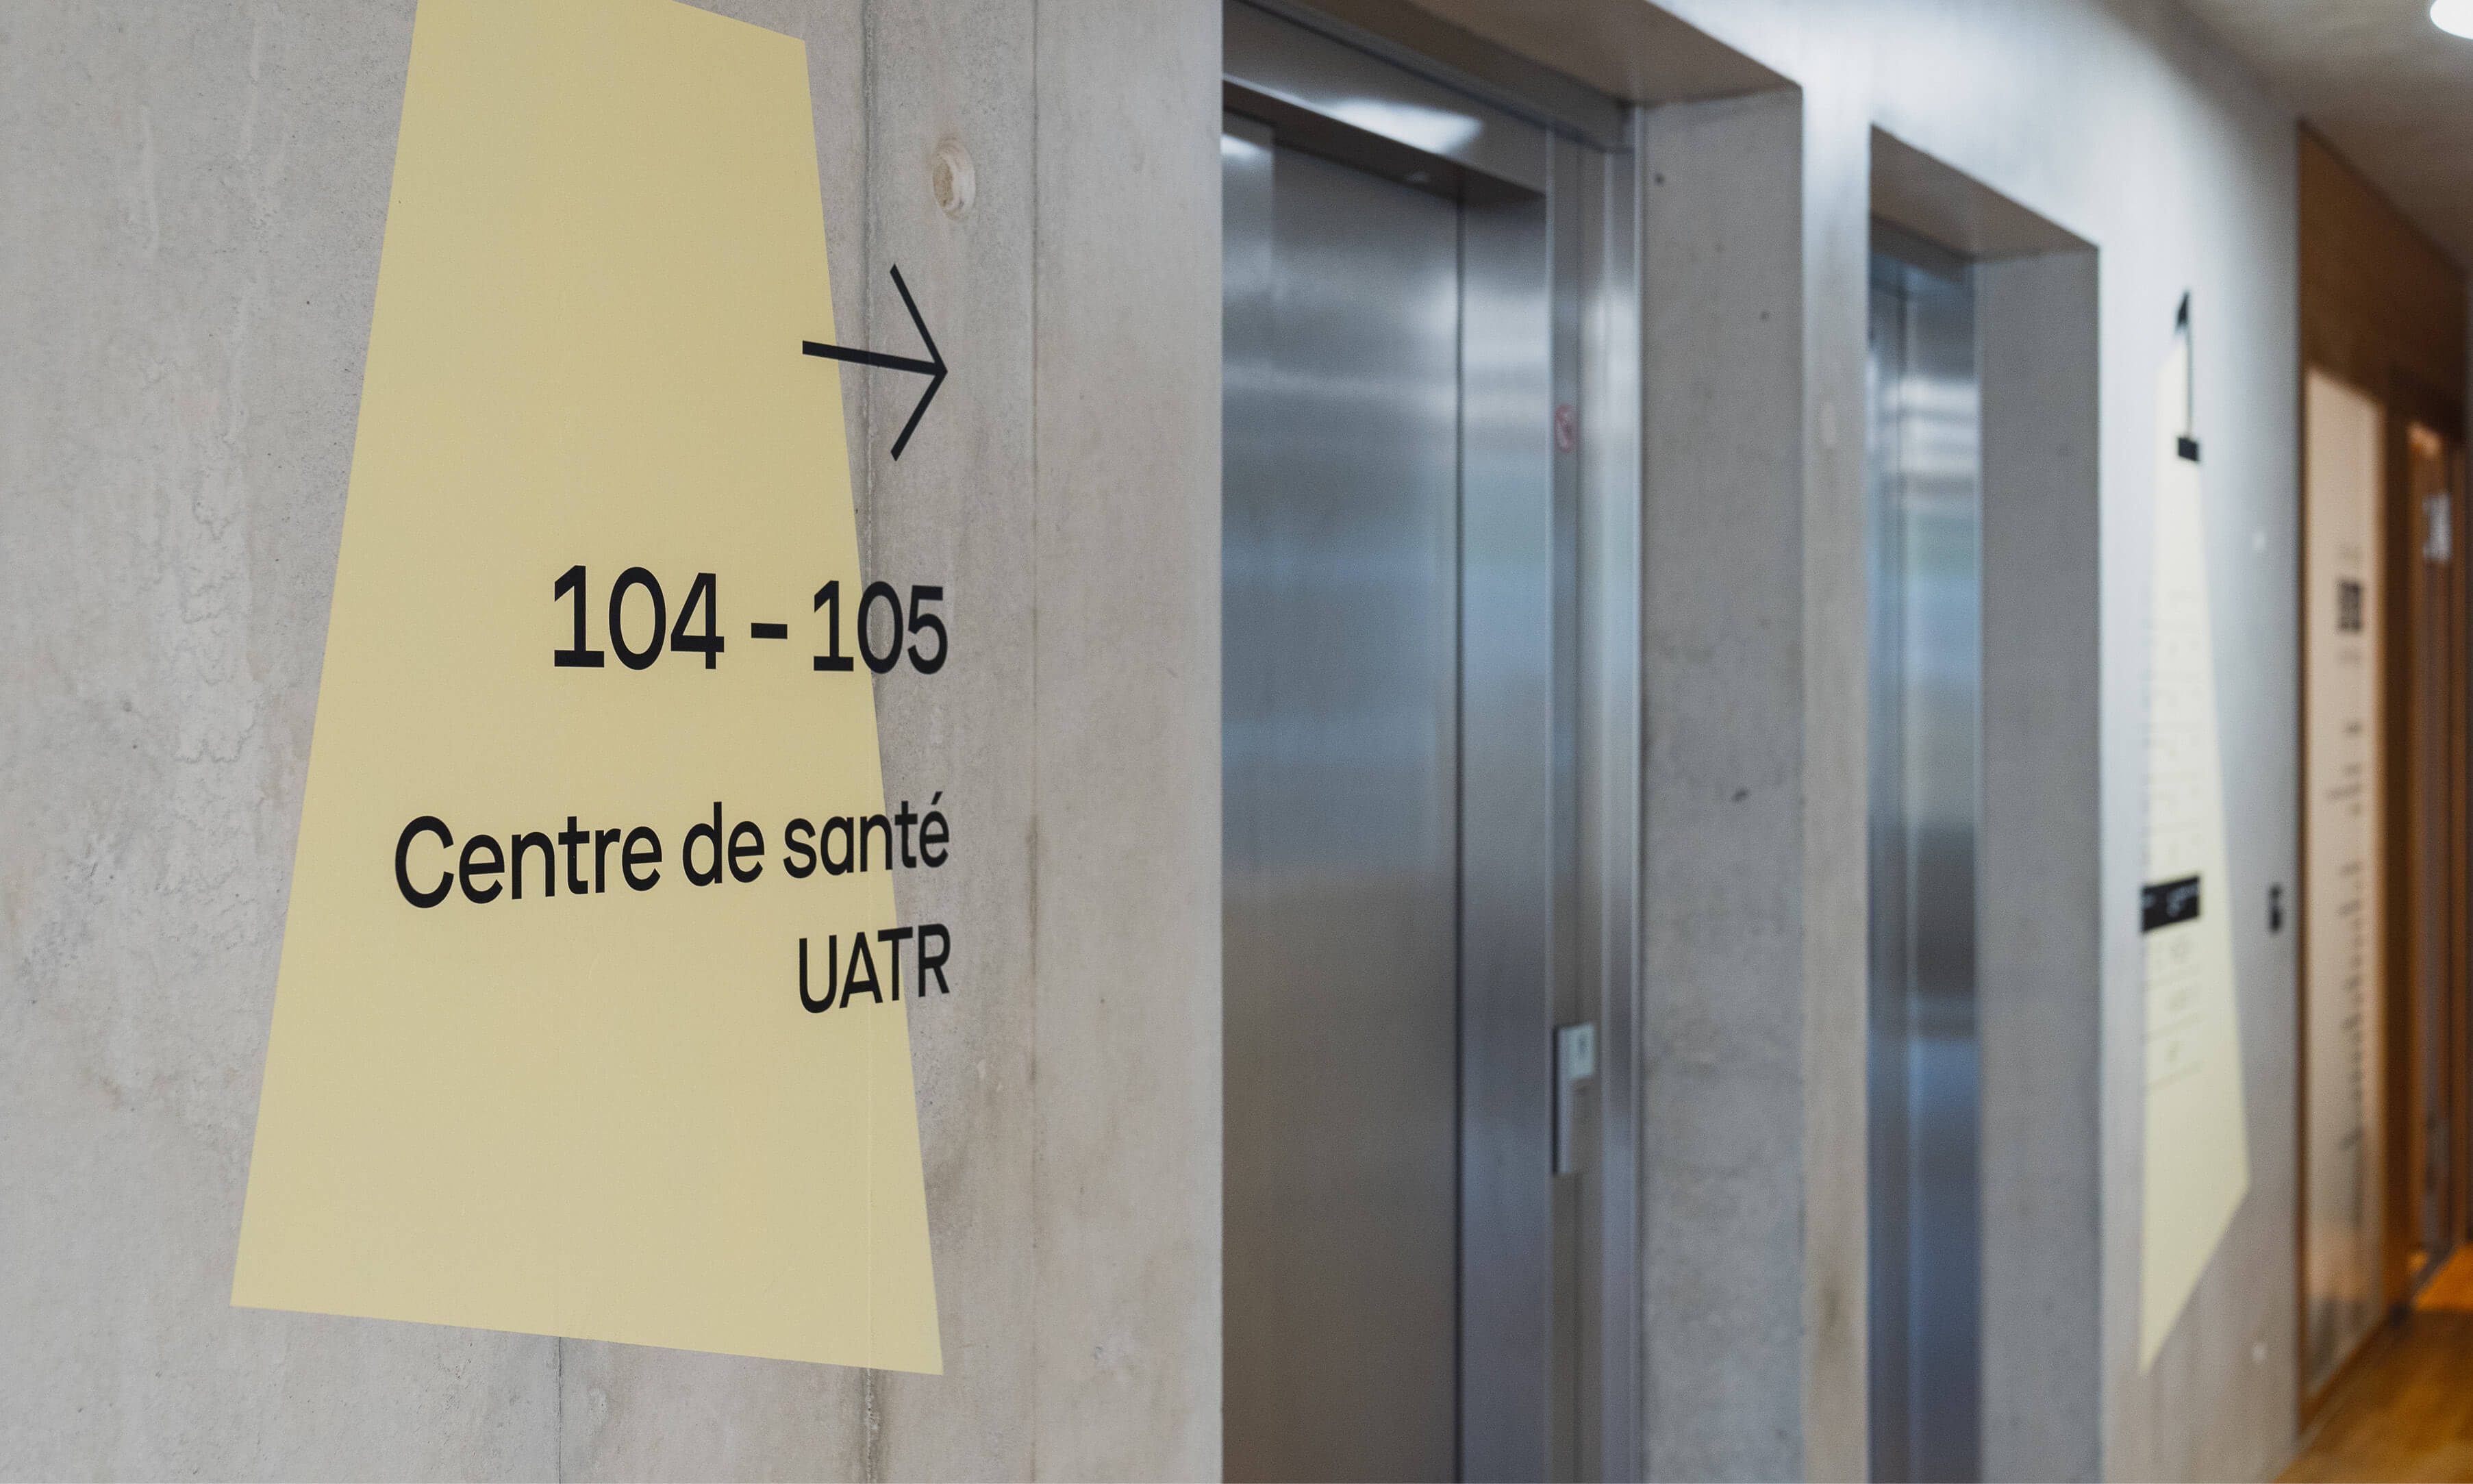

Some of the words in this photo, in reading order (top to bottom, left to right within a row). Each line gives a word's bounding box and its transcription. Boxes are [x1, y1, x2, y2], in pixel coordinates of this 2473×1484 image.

[553, 564, 726, 671] 104
[813, 579, 949, 675] 105
[394, 815, 663, 909] Centre
[681, 801, 766, 888] de
[782, 790, 950, 879] santé
[799, 922, 951, 1014] UATR
